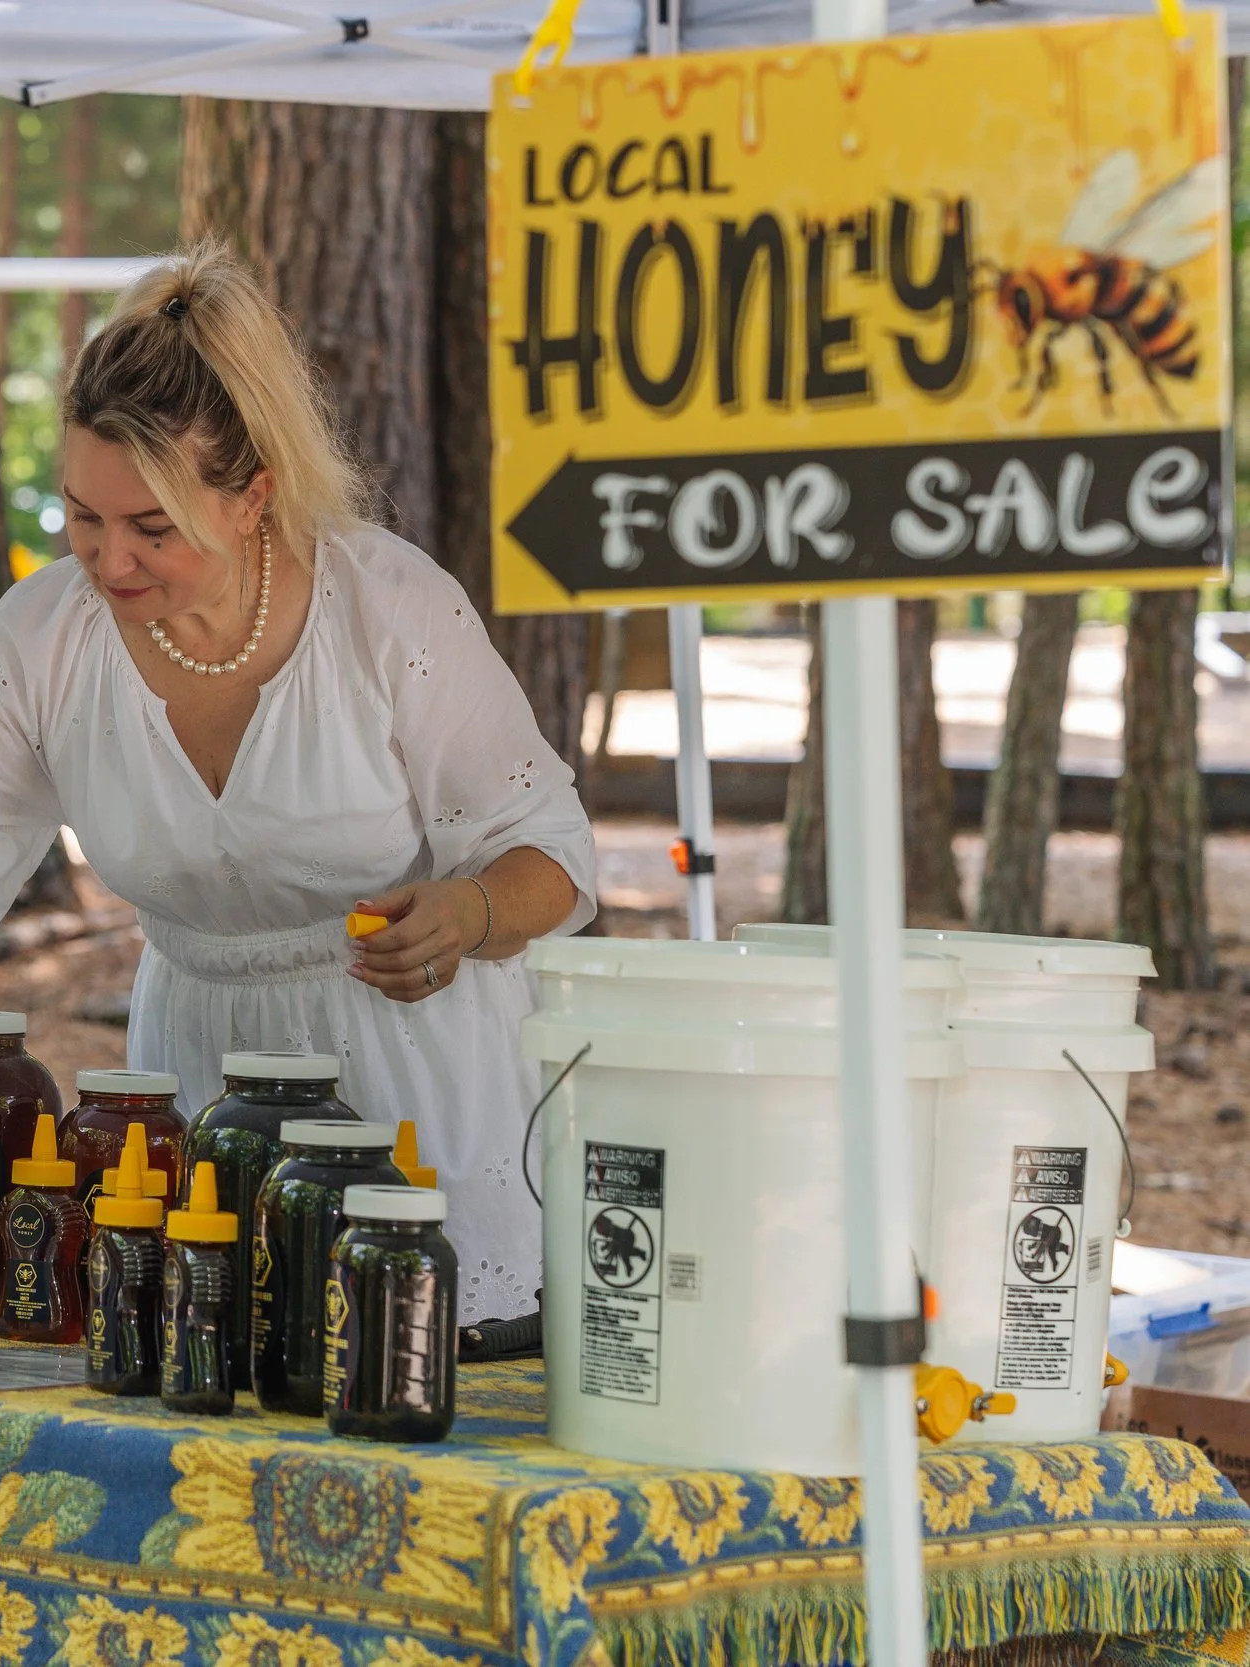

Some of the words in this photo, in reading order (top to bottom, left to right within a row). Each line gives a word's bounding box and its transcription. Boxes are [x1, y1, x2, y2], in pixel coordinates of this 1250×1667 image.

[523, 131, 735, 208] LOCAL
[504, 190, 977, 425] HONEY
[592, 463, 854, 572] FOR
[890, 447, 1212, 560] SALE
[600, 1148, 656, 1168] WARNING
[1031, 1151, 1082, 1166] WARNING
[603, 1167, 641, 1186] AVISO
[13, 1216, 41, 1230] Local
